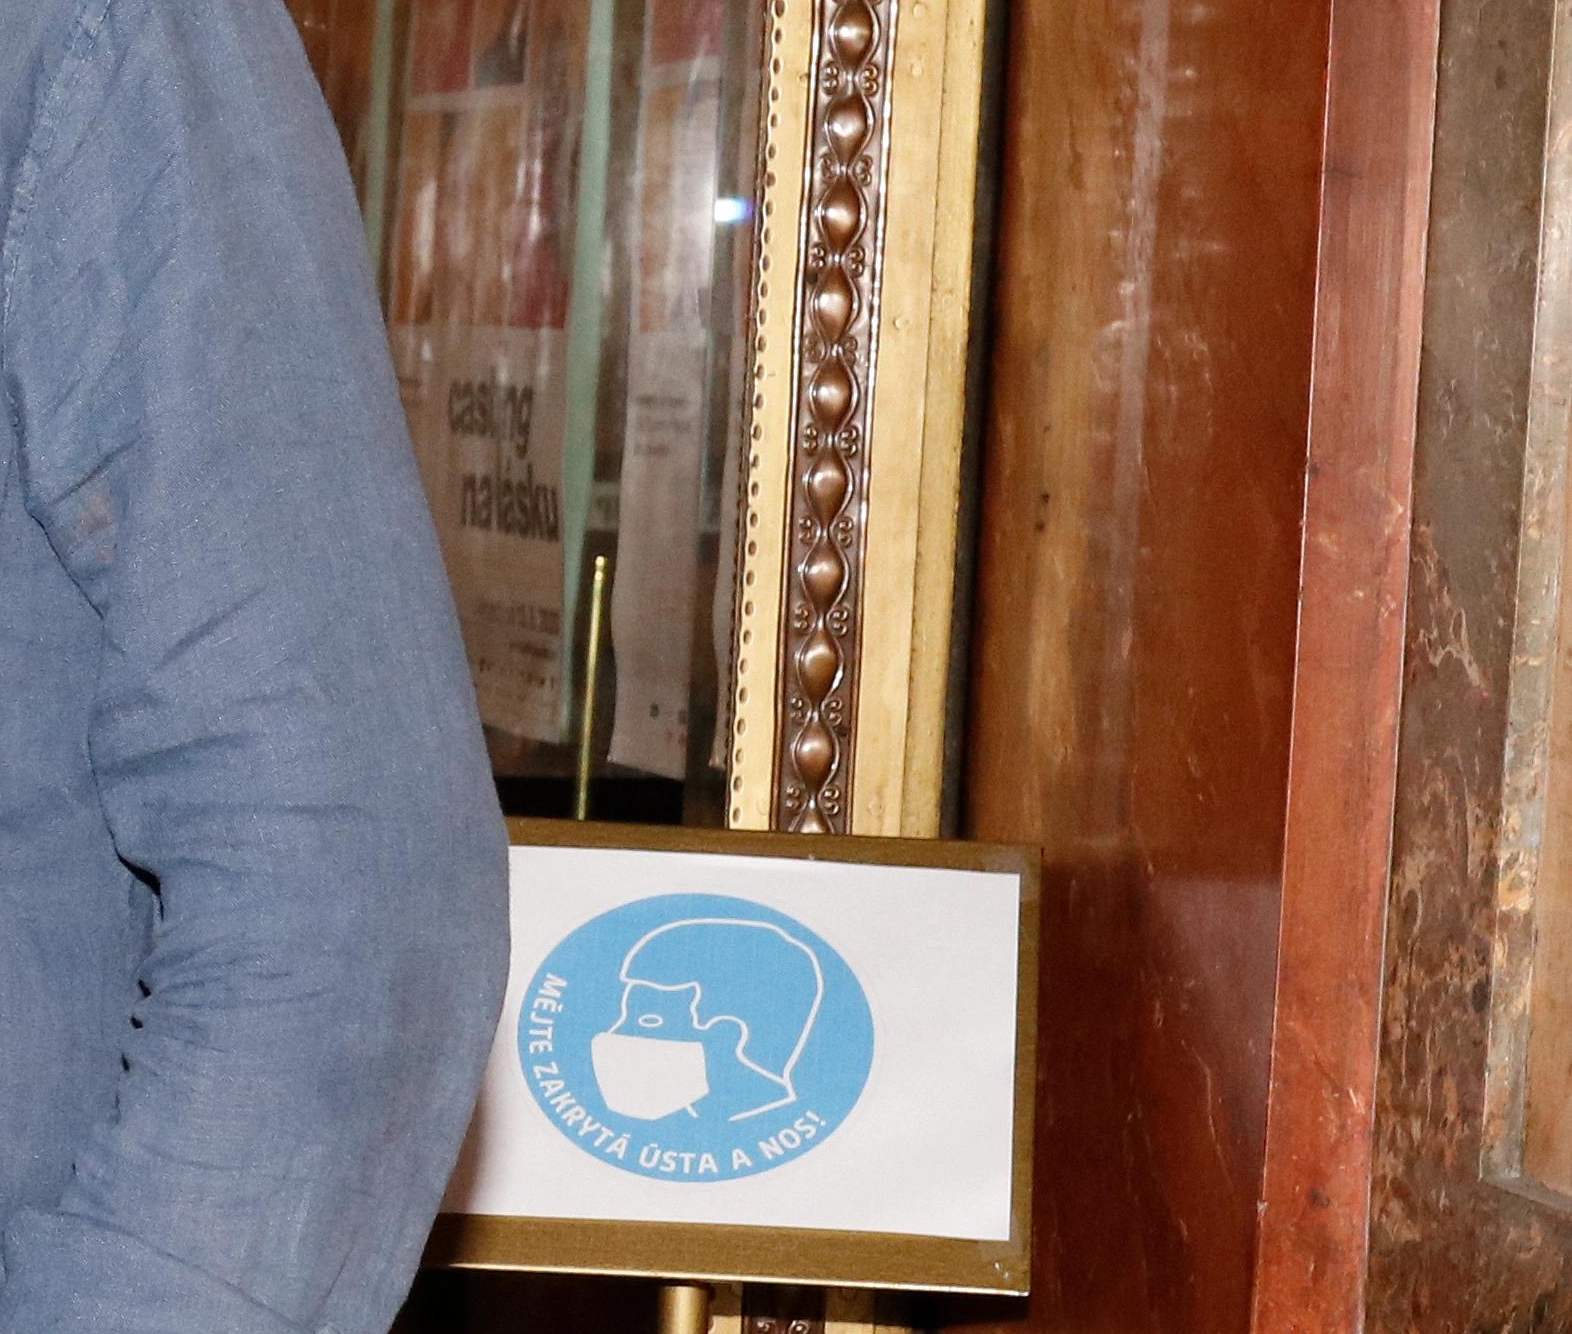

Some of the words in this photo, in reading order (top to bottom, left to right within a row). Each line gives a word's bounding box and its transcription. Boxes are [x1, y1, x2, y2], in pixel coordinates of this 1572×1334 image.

[528, 972, 568, 1055] MĚJTE
[532, 1060, 632, 1160] ZAKRYTÁ
[758, 1110, 827, 1160] NOS!
[638, 1143, 719, 1174] ÚSTA
[731, 1148, 753, 1170] A
